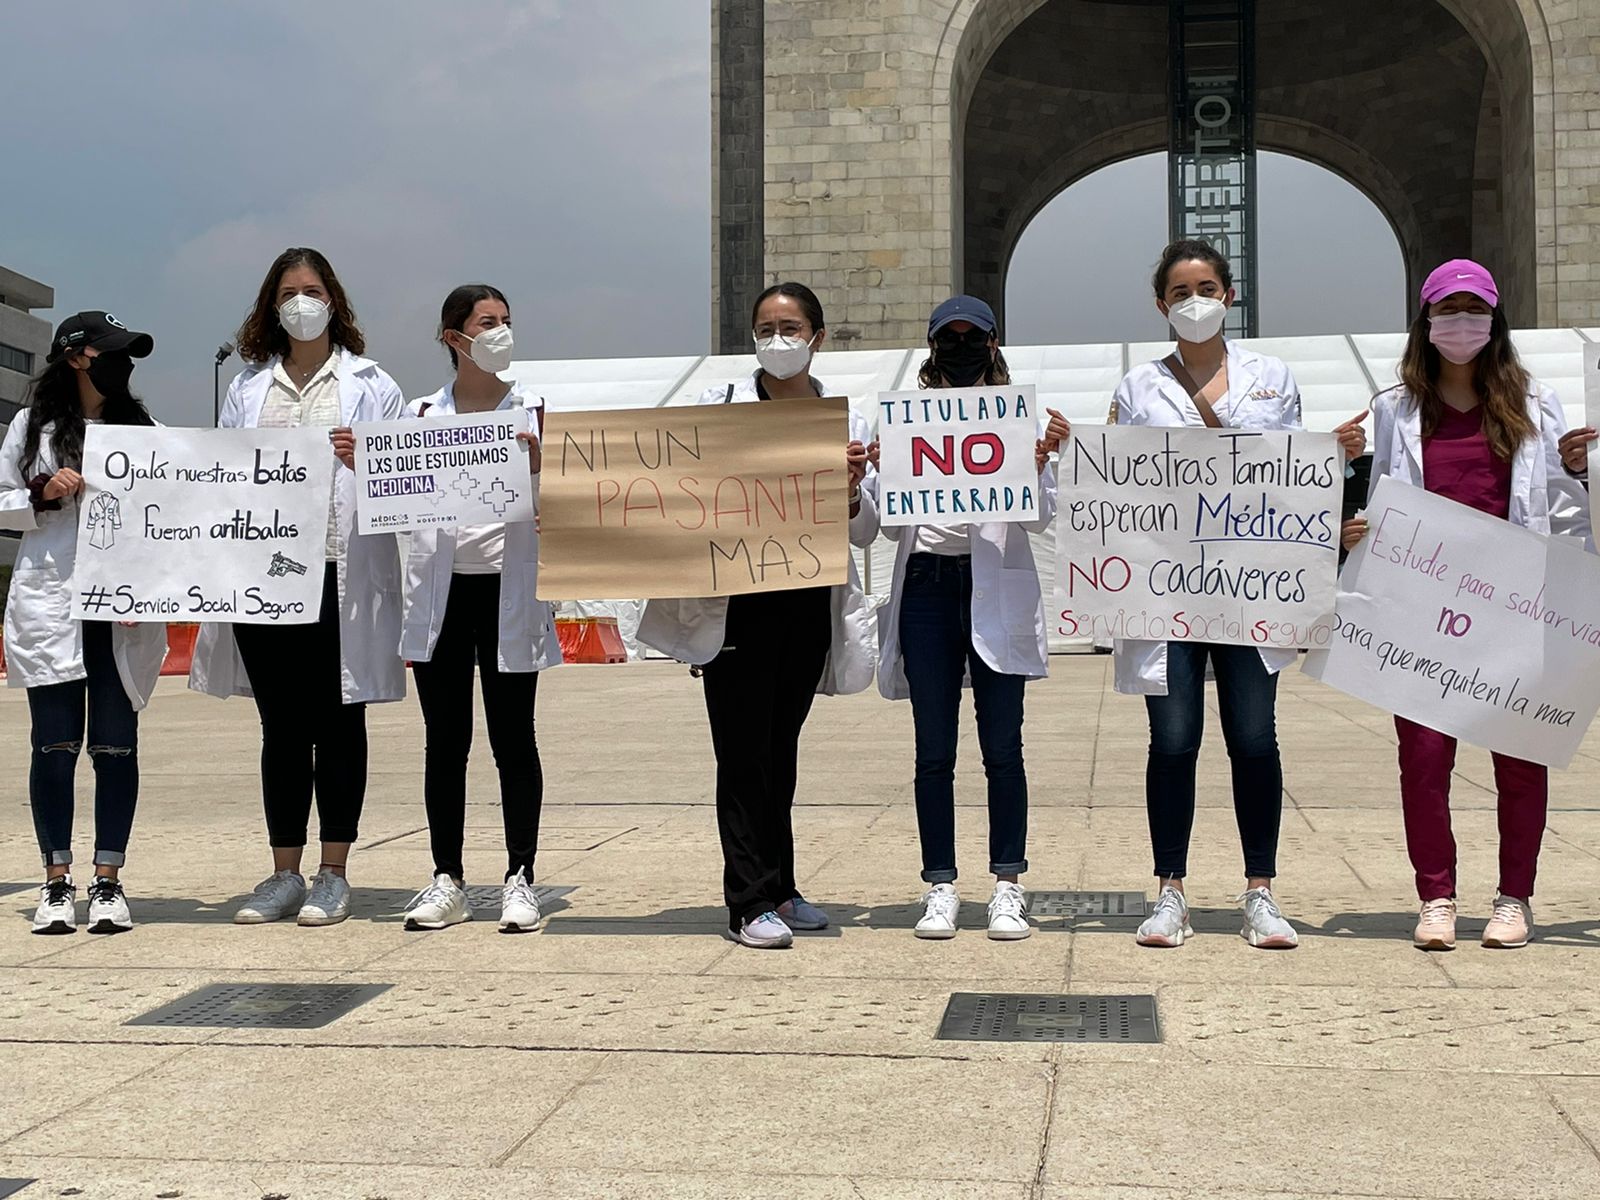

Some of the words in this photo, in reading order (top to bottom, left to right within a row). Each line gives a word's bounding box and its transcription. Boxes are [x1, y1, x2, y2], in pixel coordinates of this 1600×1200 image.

[1194, 95, 1231, 261] BIERTO
[881, 395, 1028, 424] TITULADA
[366, 435, 393, 452] POR
[397, 432, 421, 449] LOS
[425, 426, 494, 447] DERECHOS
[498, 424, 514, 441] DE
[561, 429, 607, 476] NI
[634, 426, 701, 469] UN
[912, 432, 1005, 476] NO
[1074, 432, 1217, 487] Nuestras
[1218, 432, 1334, 488] Familias
[105, 451, 169, 491] Ojalá
[176, 462, 247, 483] nuestras
[253, 449, 306, 484] batas
[368, 457, 392, 474] LXS
[397, 454, 421, 471] QUE
[426, 447, 508, 469] ESTUDIAMOS
[369, 476, 433, 497] MEDICINA
[597, 469, 838, 530] PASANTE
[887, 486, 1033, 515] ENTERRADA
[210, 509, 299, 540] antibalas
[1070, 500, 1178, 546] esperan
[1196, 492, 1332, 542] Médicxs
[709, 534, 821, 591] MÁS
[1069, 556, 1131, 598] NO
[1150, 544, 1306, 603] cadáveres
[1371, 507, 1448, 582] Estudie
[1456, 573, 1495, 600] para
[1505, 583, 1569, 628] salvar
[81, 585, 179, 614] #Servicio
[188, 585, 236, 613] Social
[245, 587, 304, 620] Seguro
[1436, 606, 1472, 638] no
[1376, 641, 1414, 671] que
[1414, 657, 1442, 679] me
[1440, 667, 1500, 706] quiten
[1504, 677, 1529, 715] la
